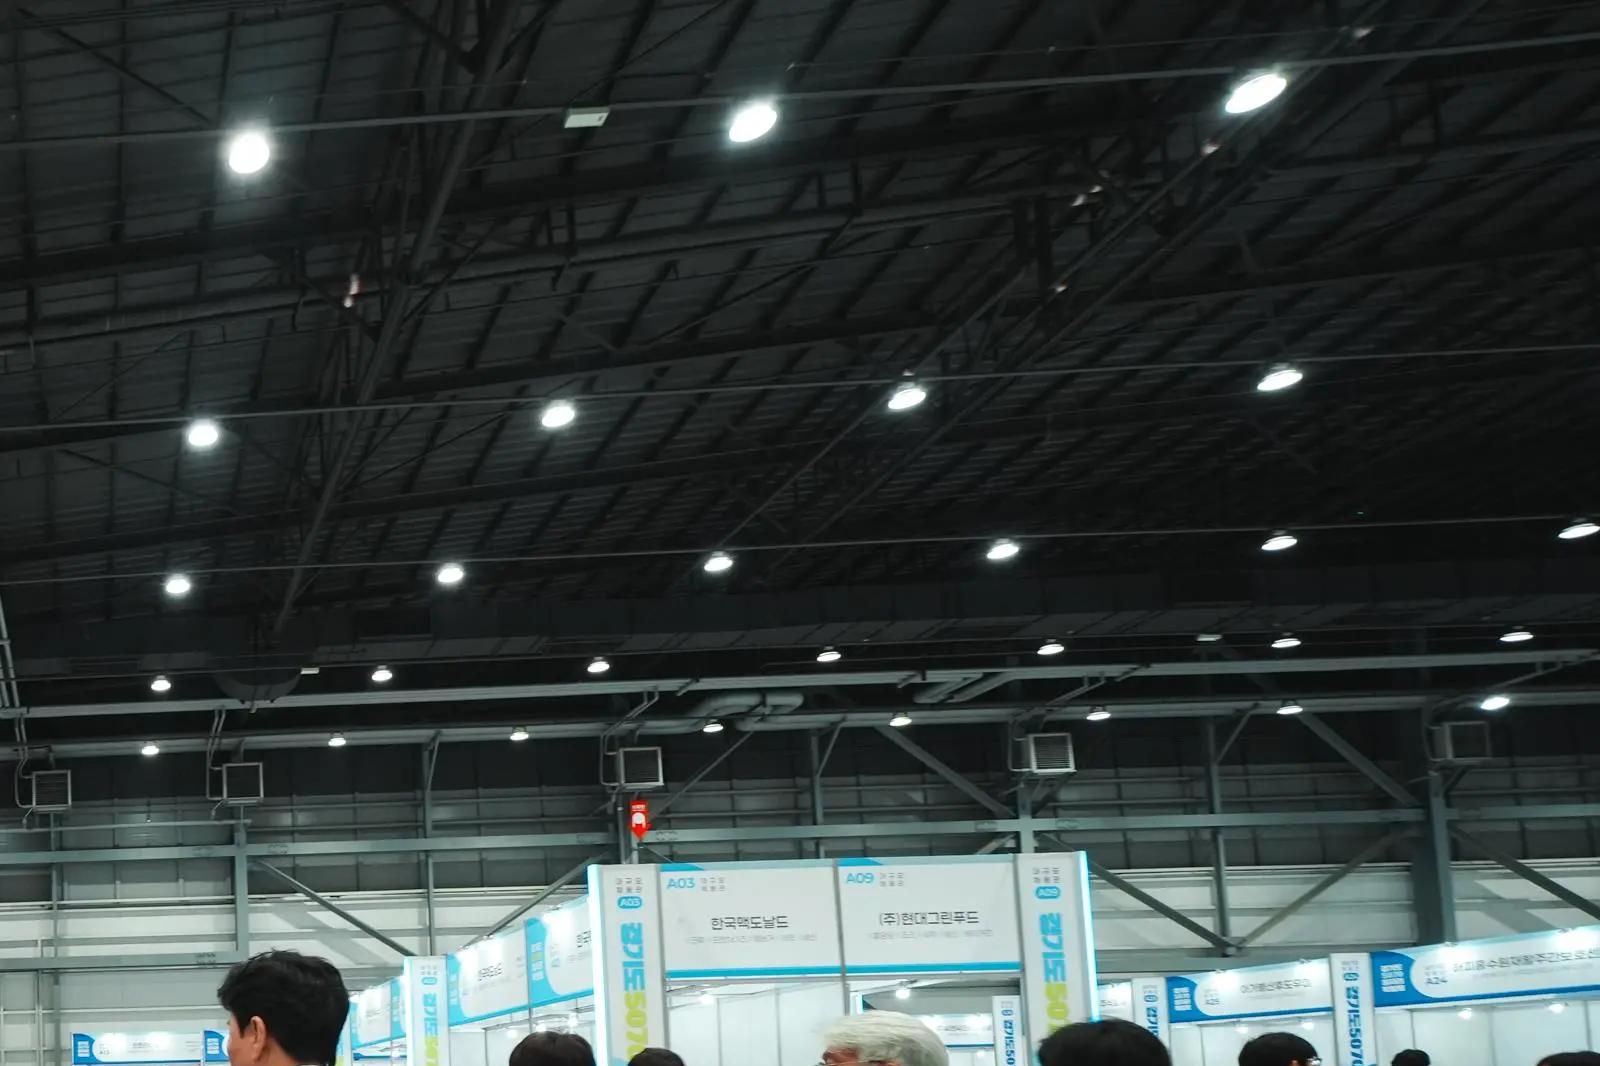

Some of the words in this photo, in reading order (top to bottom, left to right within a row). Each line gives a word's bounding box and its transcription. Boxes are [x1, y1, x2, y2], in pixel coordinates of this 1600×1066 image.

[667, 877, 696, 890] A03
[846, 872, 875, 884] A09
[711, 915, 789, 931] 한국맥도날드
[879, 911, 980, 926] (주)현대그린푸드
